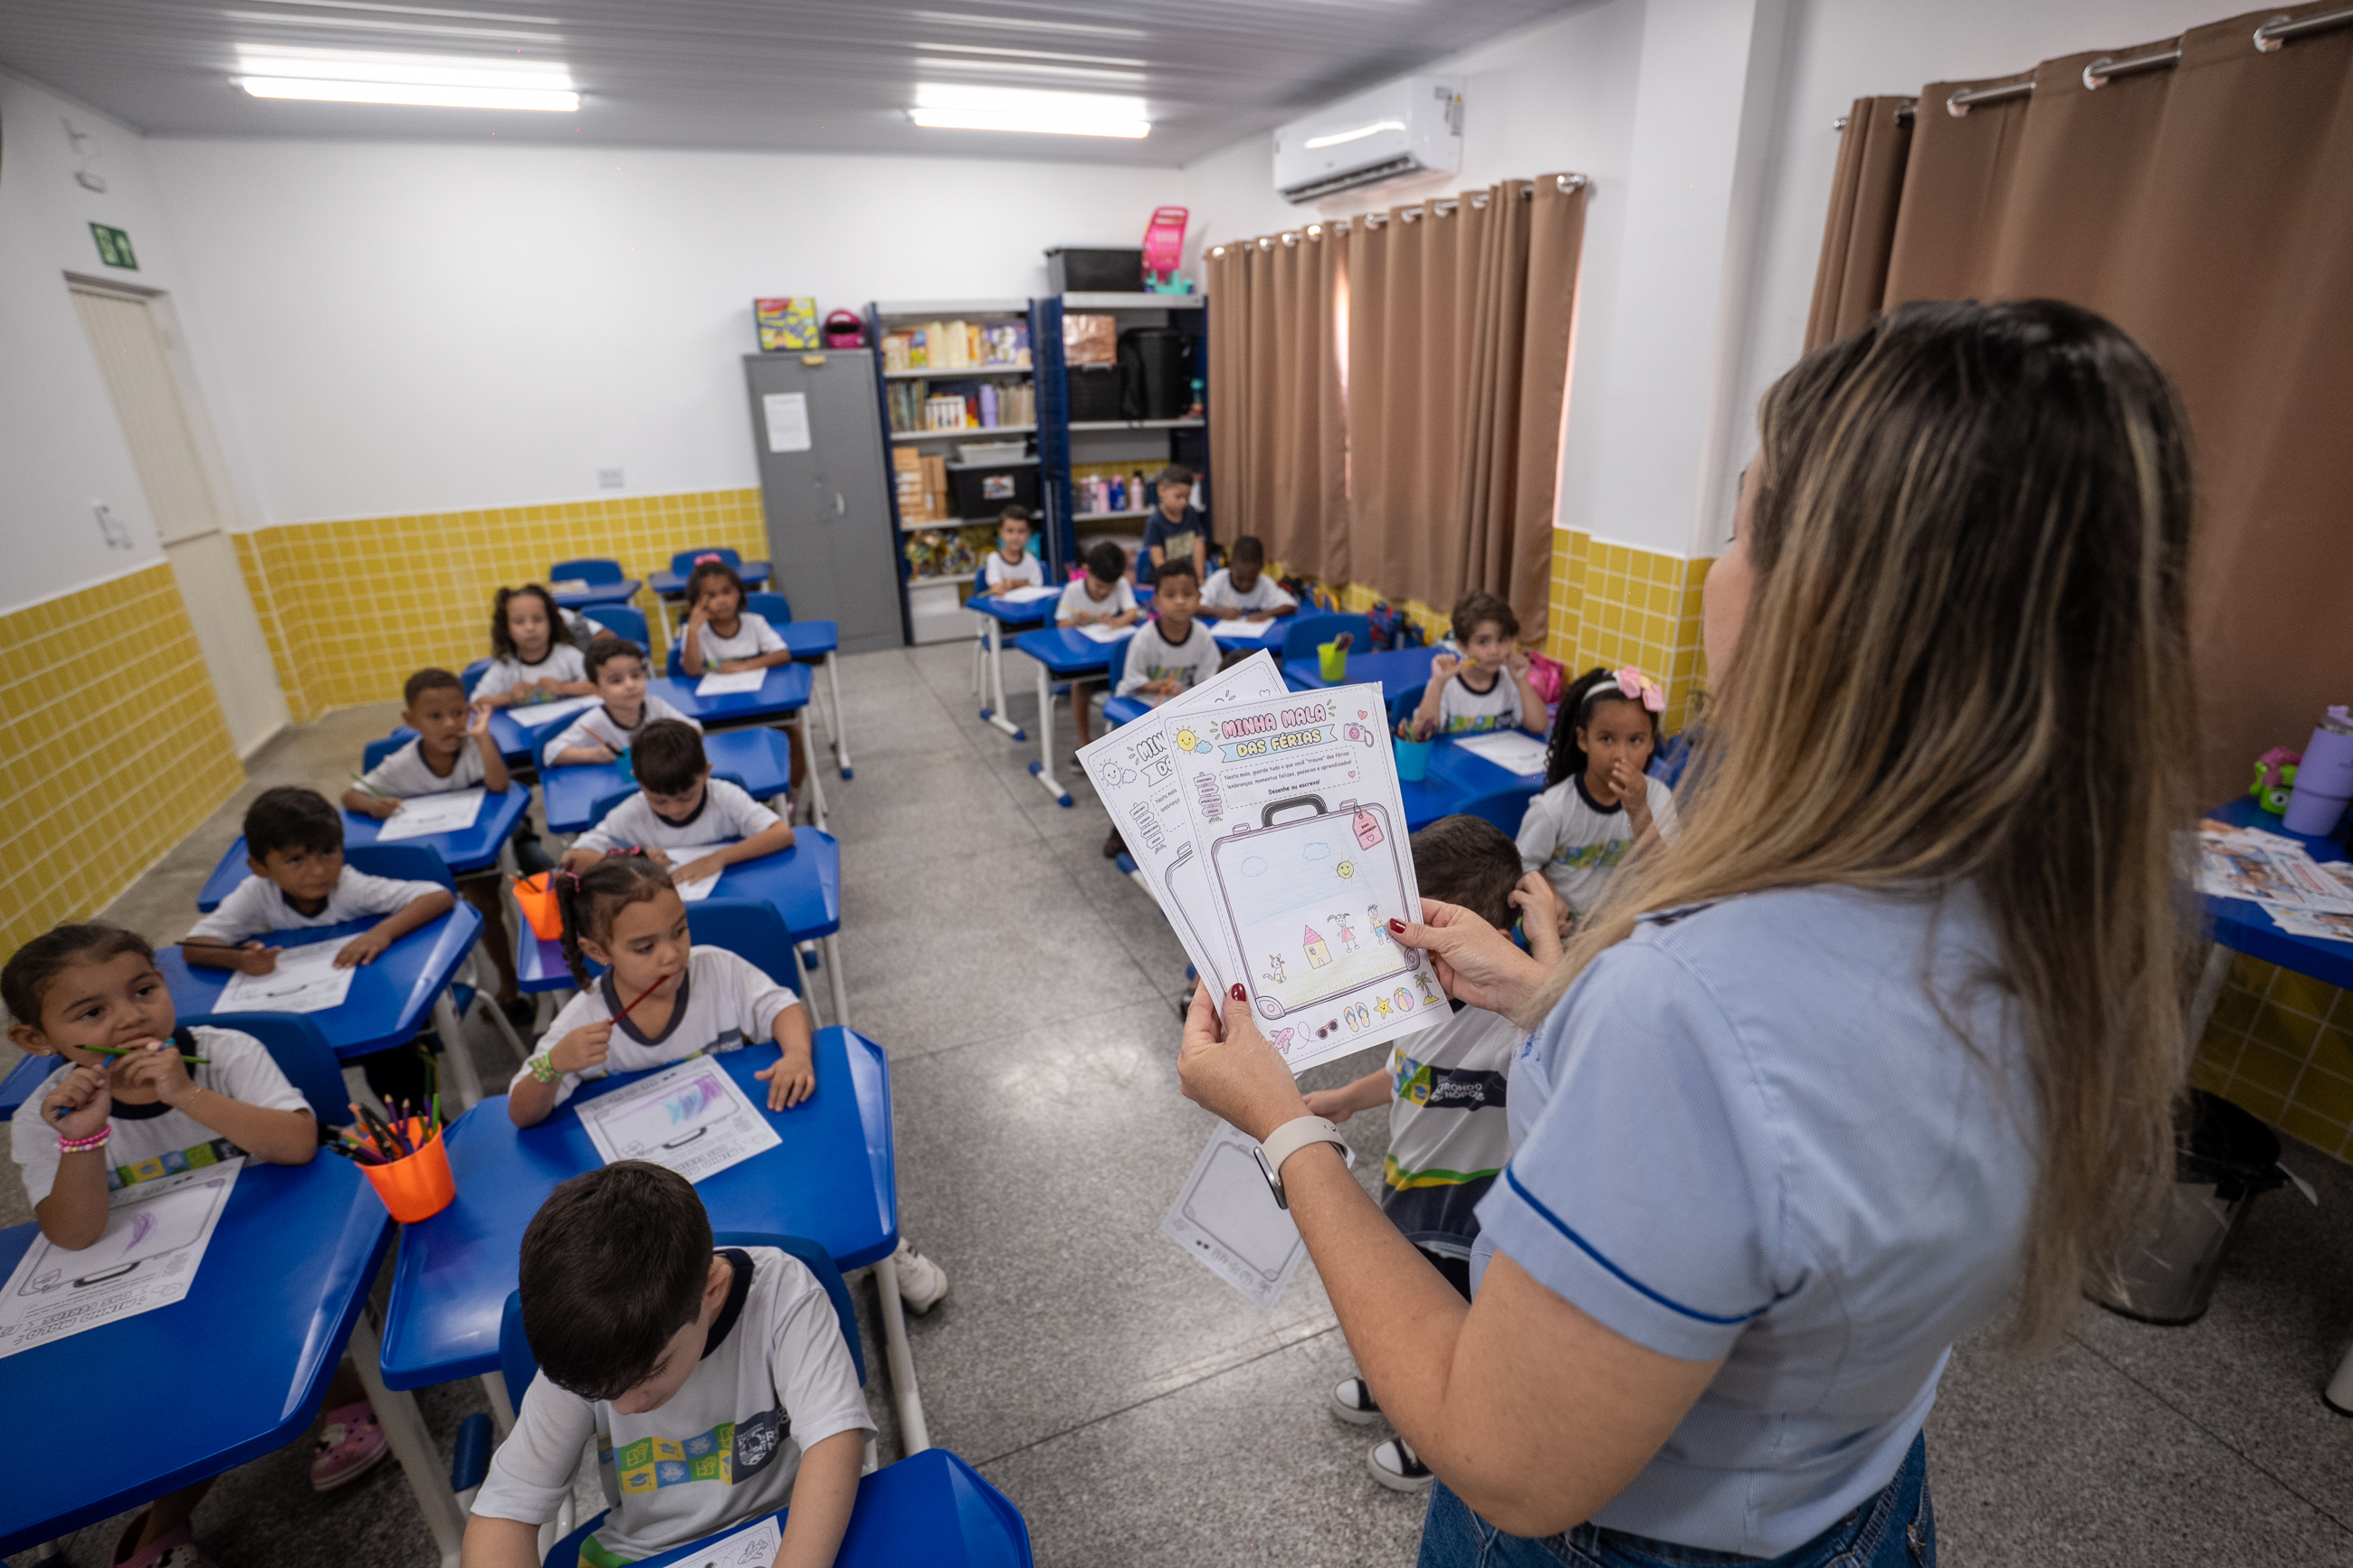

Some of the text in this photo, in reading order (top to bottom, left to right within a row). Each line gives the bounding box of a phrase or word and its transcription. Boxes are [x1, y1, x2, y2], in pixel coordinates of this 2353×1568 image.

[1222, 704, 1327, 739] MINHA MALA
[1136, 730, 1167, 761] MIN
[1236, 729, 1322, 758] DAS FÉRIAS
[1156, 755, 1172, 776] DA
[1227, 780, 1254, 790] lembranças,
[1255, 775, 1278, 784] momentos
[1278, 771, 1296, 780] felizes,
[1297, 768, 1316, 777] passeios
[1321, 759, 1352, 772] aprendizados!
[1253, 768, 1268, 777] guarde
[1155, 793, 1167, 804] Nesta
[1268, 785, 1290, 795] Desenhe
[1299, 779, 1320, 789] escreva!
[1160, 797, 1180, 813] lembrança
[80, 1298, 137, 1323] MINHA
